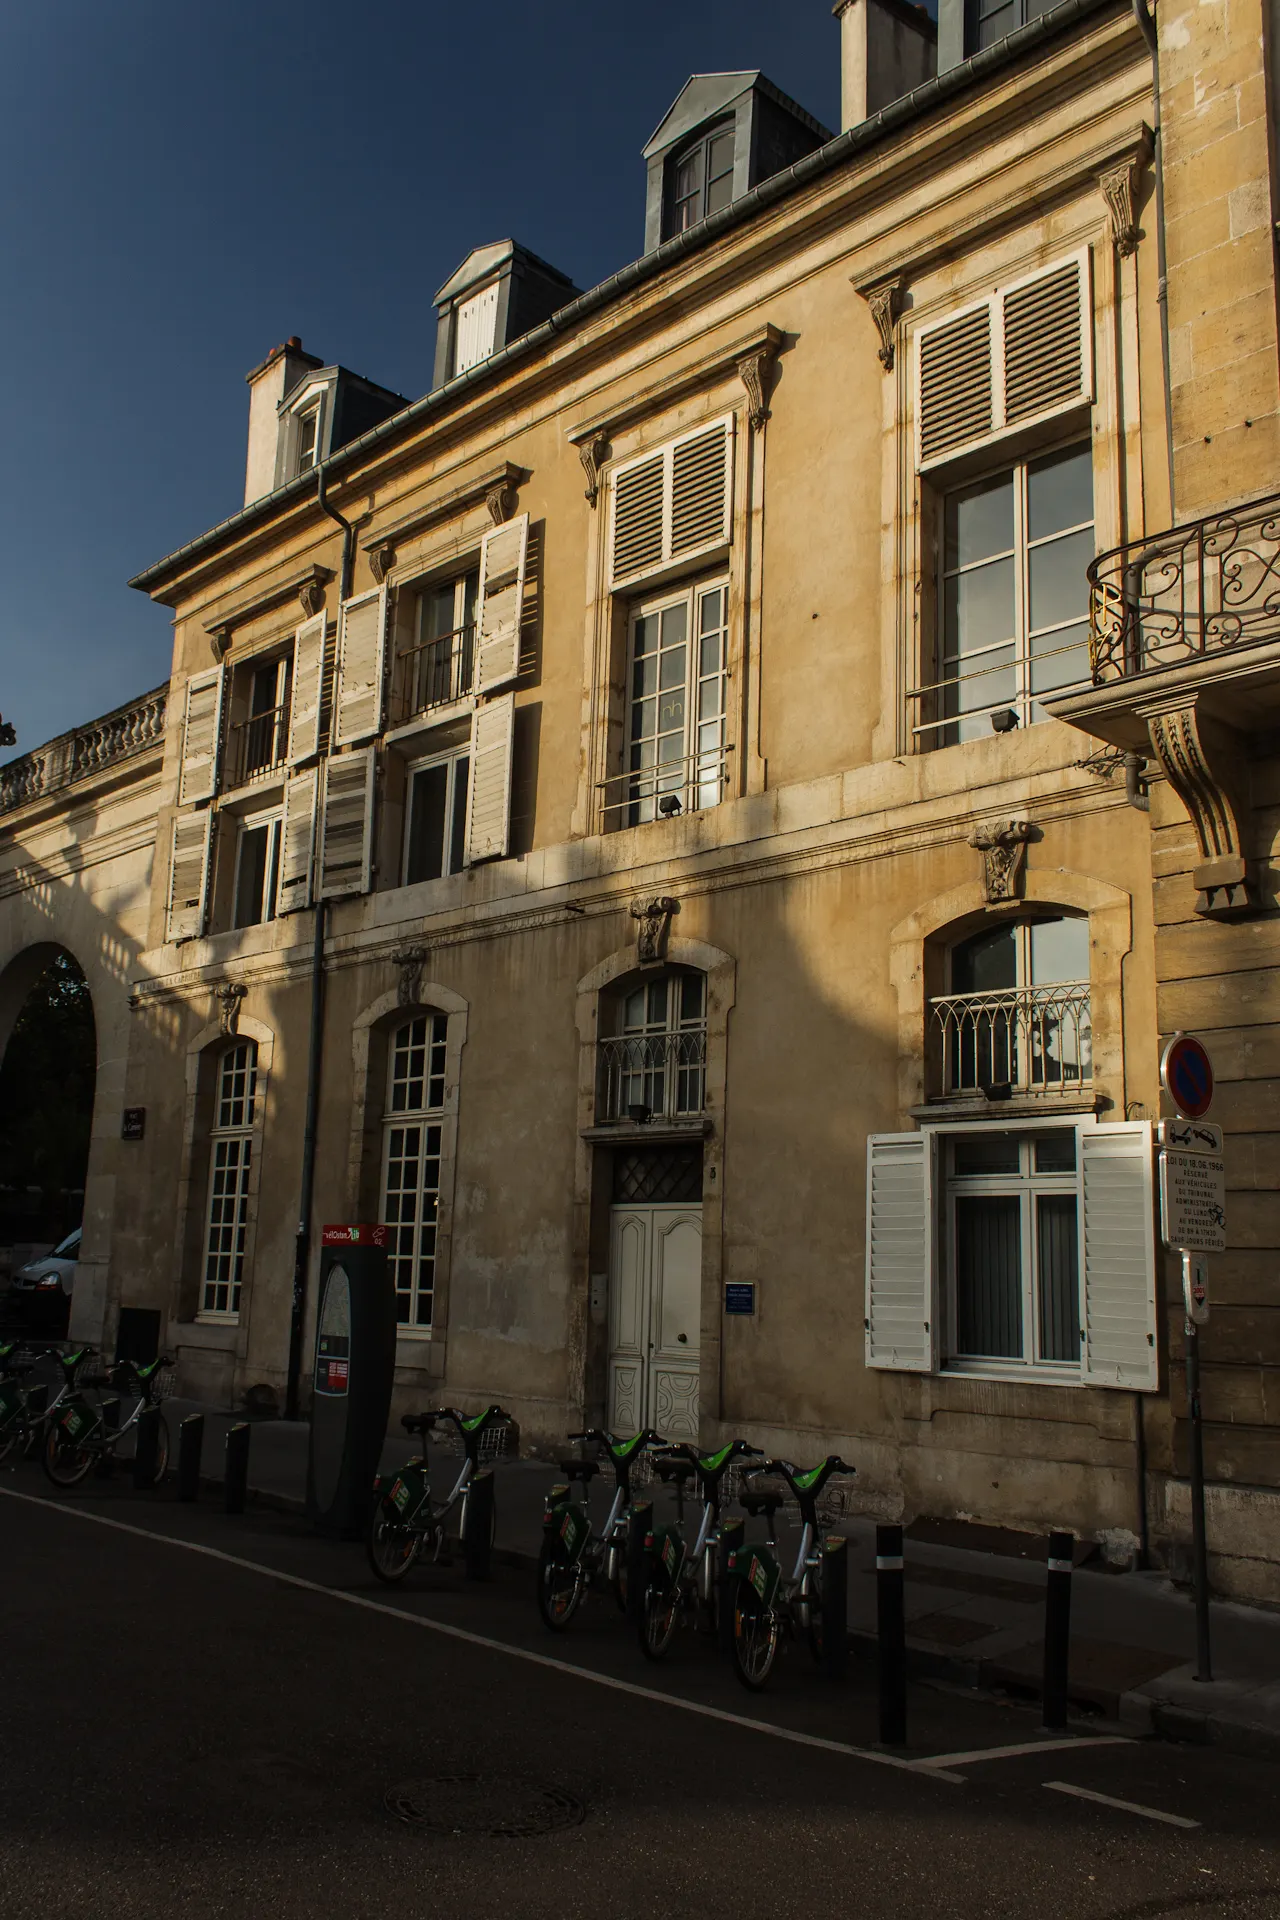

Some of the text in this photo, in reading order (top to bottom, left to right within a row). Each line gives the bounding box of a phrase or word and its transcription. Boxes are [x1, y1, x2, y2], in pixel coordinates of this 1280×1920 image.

[1166, 1155, 1177, 1165] LOI
[1179, 1157, 1187, 1166] DU
[710, 1166, 716, 1179] 3
[1188, 1189, 1215, 1199] TRIBUNAL
[1178, 1226, 1185, 1234] DE
[1170, 1235, 1185, 1243] SAUF
[1186, 1236, 1204, 1245] JOURS
